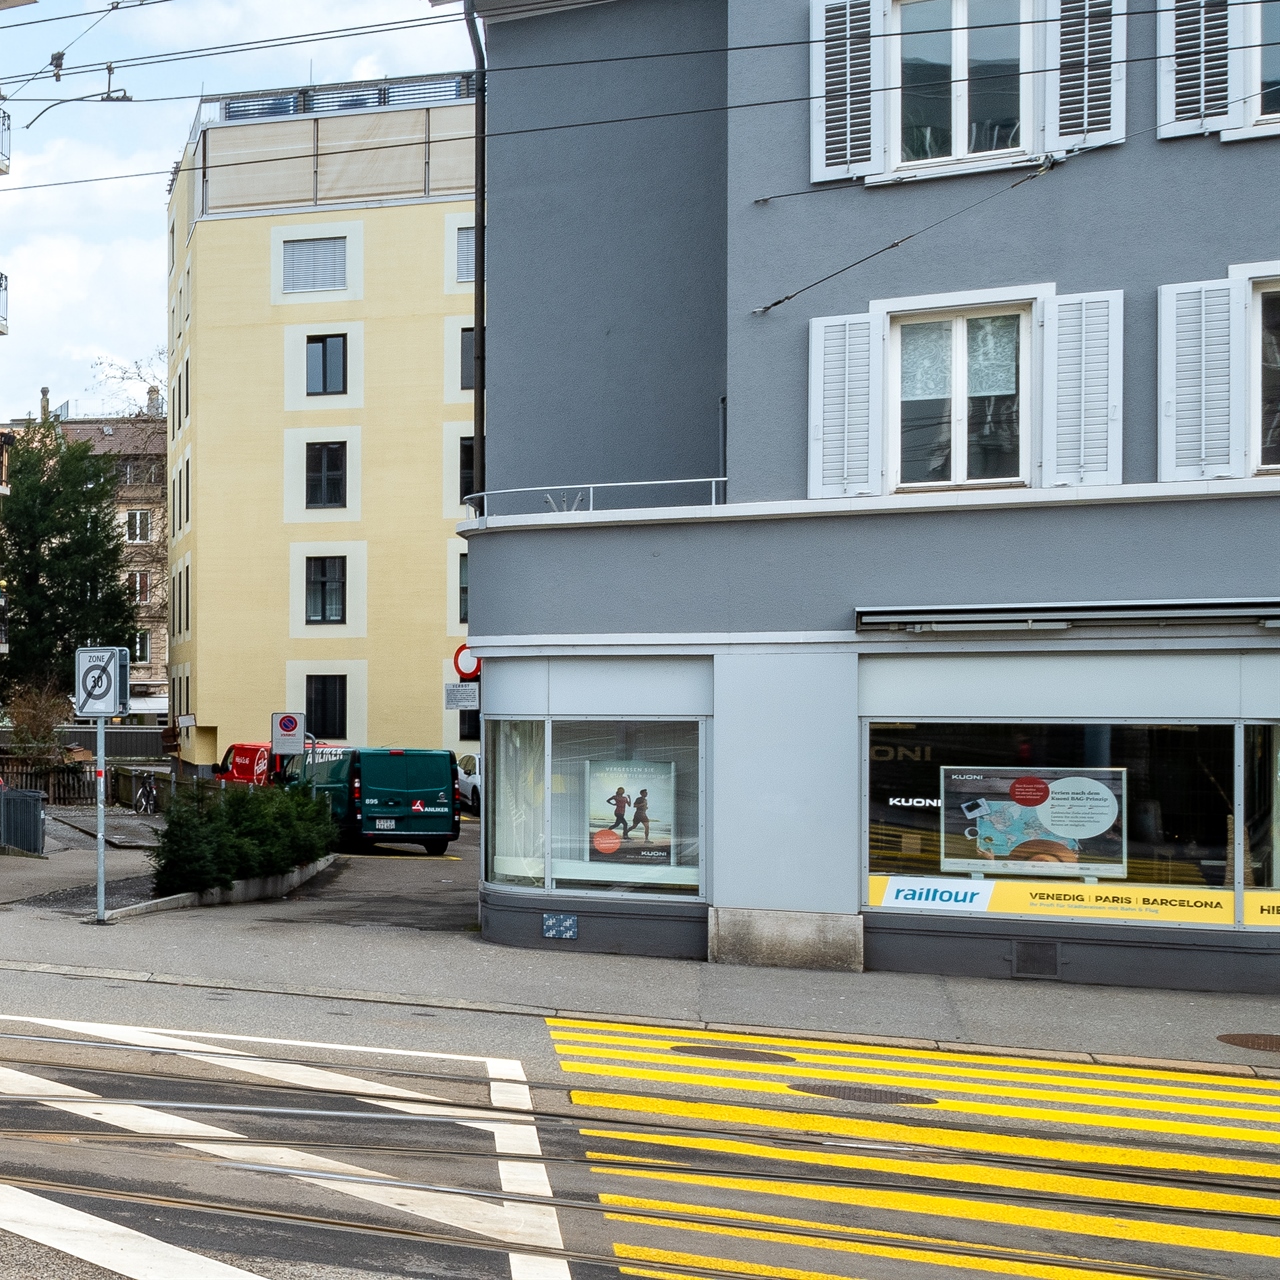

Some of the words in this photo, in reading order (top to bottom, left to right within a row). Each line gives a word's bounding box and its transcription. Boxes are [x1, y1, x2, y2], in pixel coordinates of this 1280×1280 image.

[91, 676, 103, 688] 30
[889, 797, 941, 807] KUONI
[894, 887, 980, 904] railtour
[1029, 892, 1085, 902] VENEDIG
[1095, 895, 1132, 904] PARIS
[1142, 898, 1224, 909] BARCELONA
